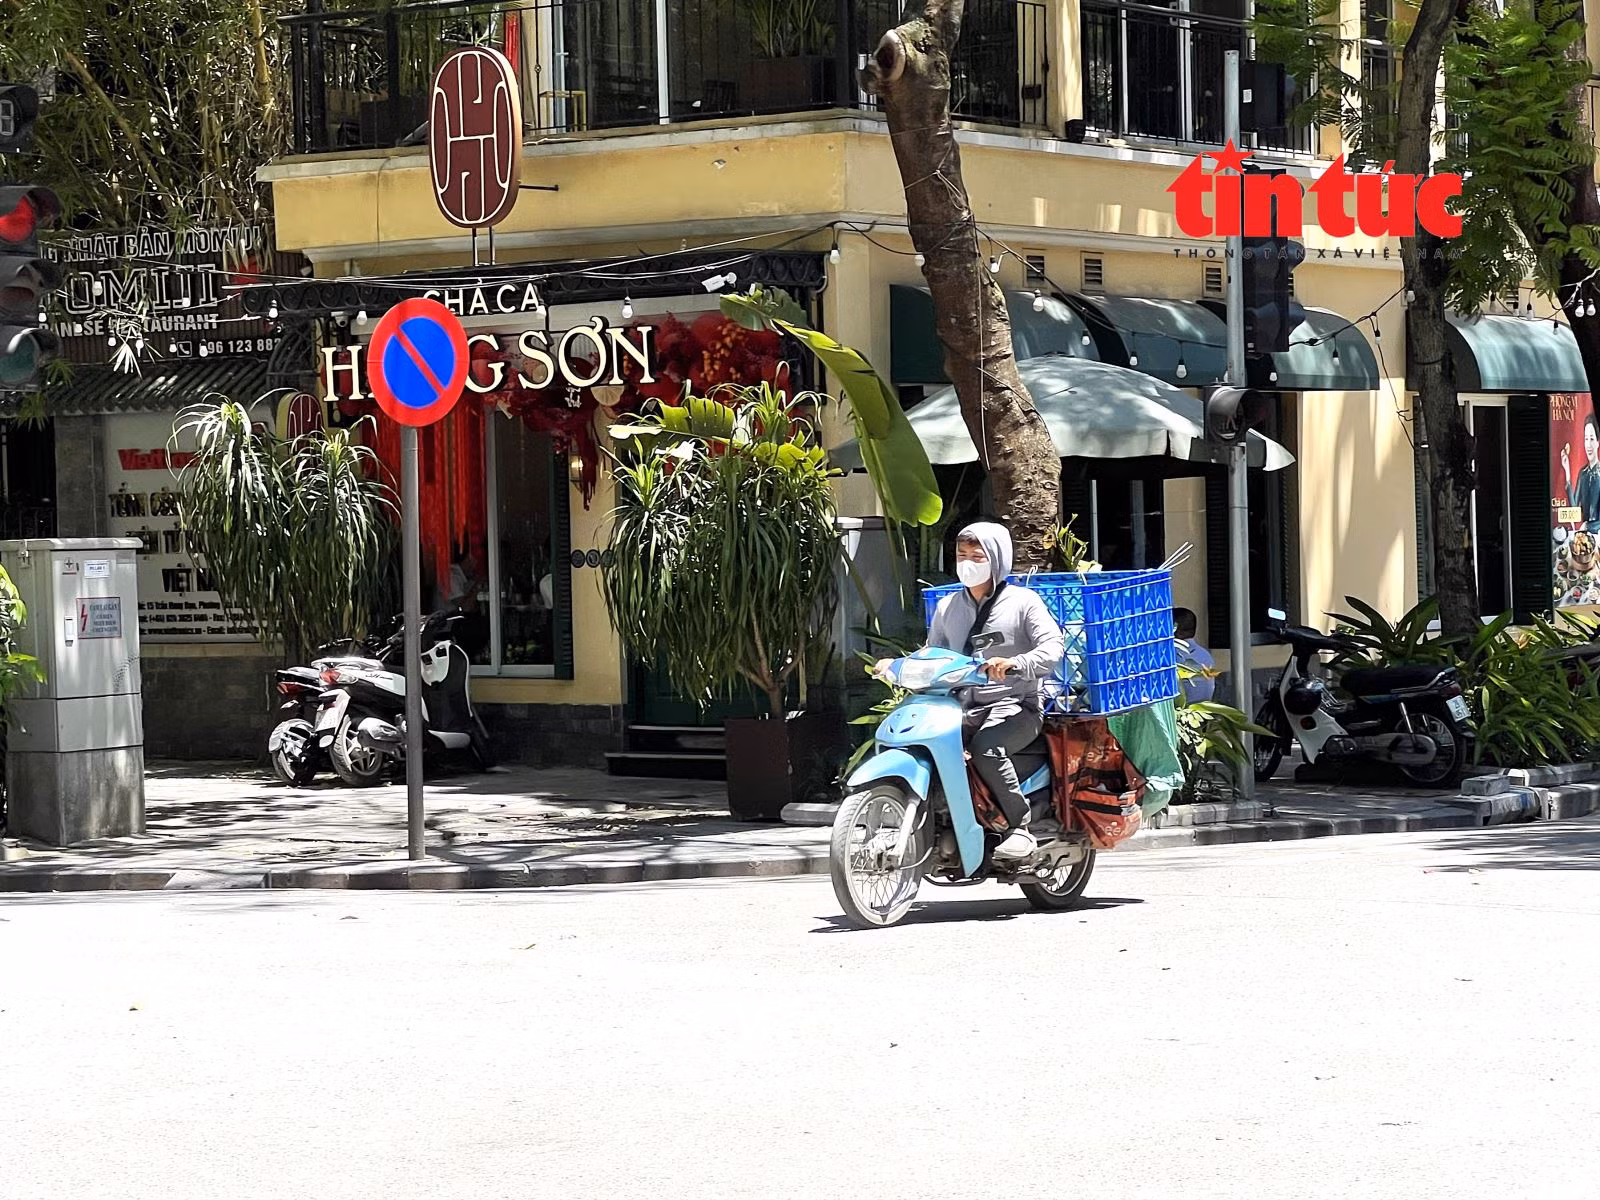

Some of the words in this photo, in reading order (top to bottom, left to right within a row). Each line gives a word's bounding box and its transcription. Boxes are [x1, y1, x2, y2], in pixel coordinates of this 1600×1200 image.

[124, 226, 170, 258] BẢN
[48, 264, 218, 315] OMIJI
[200, 340, 223, 355] 96
[227, 339, 252, 353] 123
[517, 316, 656, 391] SƠN
